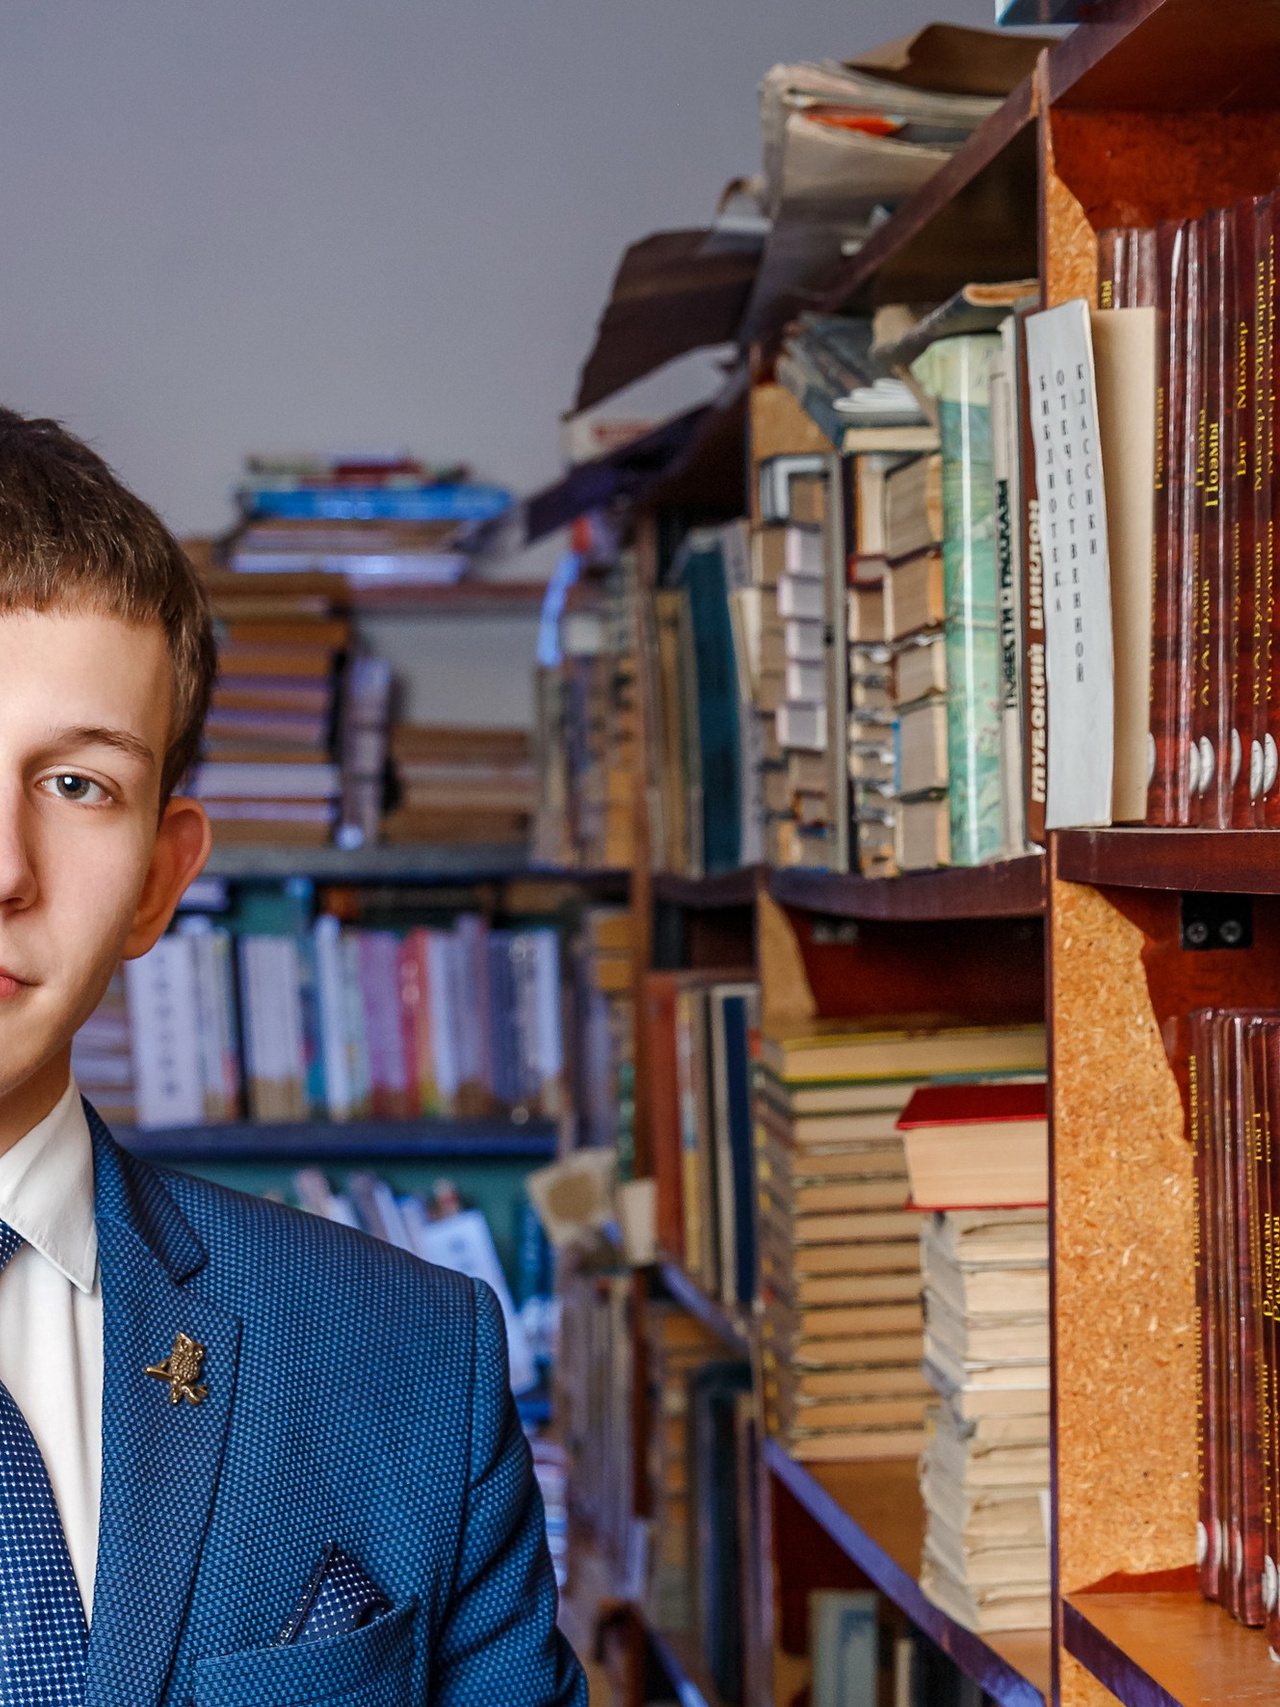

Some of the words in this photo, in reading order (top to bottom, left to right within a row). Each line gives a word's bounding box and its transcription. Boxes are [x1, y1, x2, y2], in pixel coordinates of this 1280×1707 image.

[1235, 321, 1249, 410] Мольер
[1254, 261, 1267, 382] Маргарита
[1257, 389, 1264, 402] и
[1037, 373, 1062, 612] БИБЛИОТЕКА
[1075, 363, 1098, 556] КЛАССИКИ
[1204, 422, 1219, 507] Поэмы
[1235, 437, 1247, 477] Бег
[1254, 408, 1266, 492] Мастер
[1028, 498, 1044, 631] ЦИКЛОН
[1056, 368, 1085, 683] ОТЕЧЕСТВЕННОЙ
[1200, 579, 1211, 635] Блок
[1253, 542, 1263, 638] Булгаков
[1252, 645, 1261, 670] А.
[1252, 676, 1261, 706] М.
[1027, 642, 1046, 804] ГЛУБОКИЙ
[1188, 1054, 1199, 1158] Рассказы
[1254, 1128, 1263, 1161] Том
[1262, 1212, 1274, 1317] Рассказы
